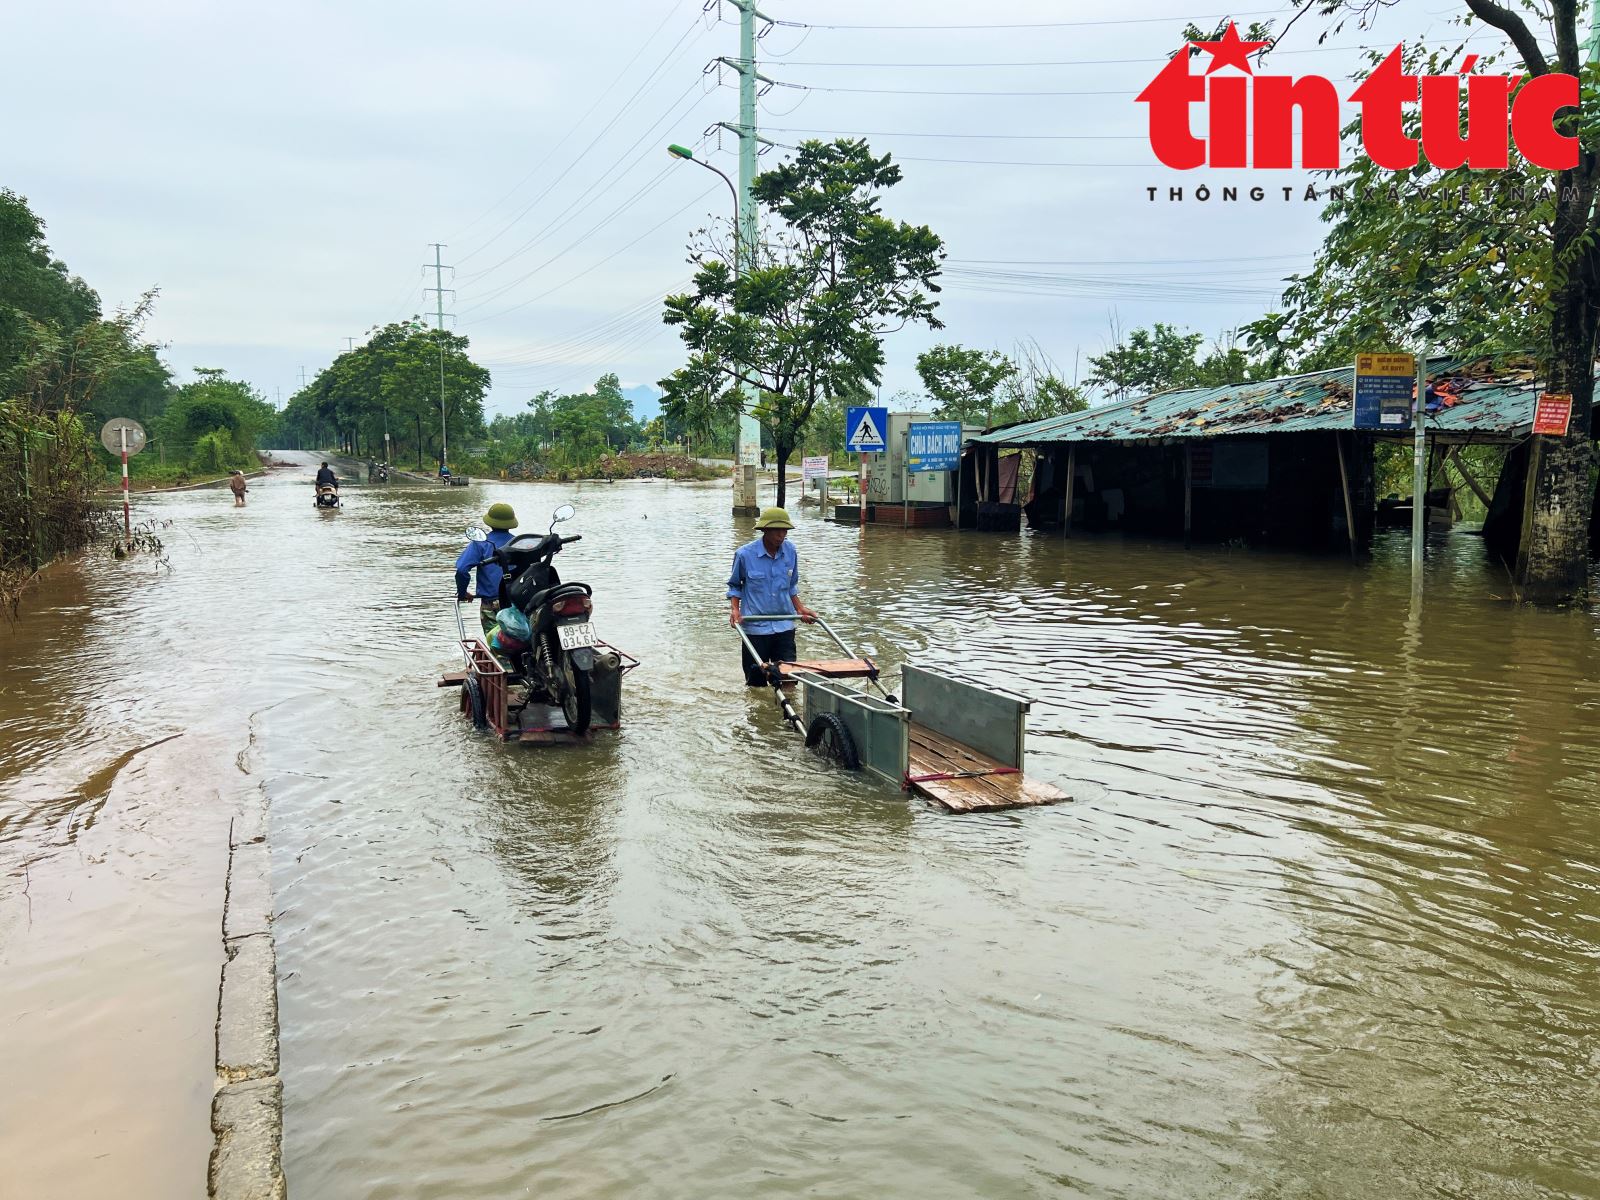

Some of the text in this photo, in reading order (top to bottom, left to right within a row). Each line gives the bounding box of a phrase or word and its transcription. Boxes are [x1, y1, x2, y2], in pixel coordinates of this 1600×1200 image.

[911, 430, 959, 455] CHÙA BÁCH PHÚC
[562, 634, 596, 648] 034.64
